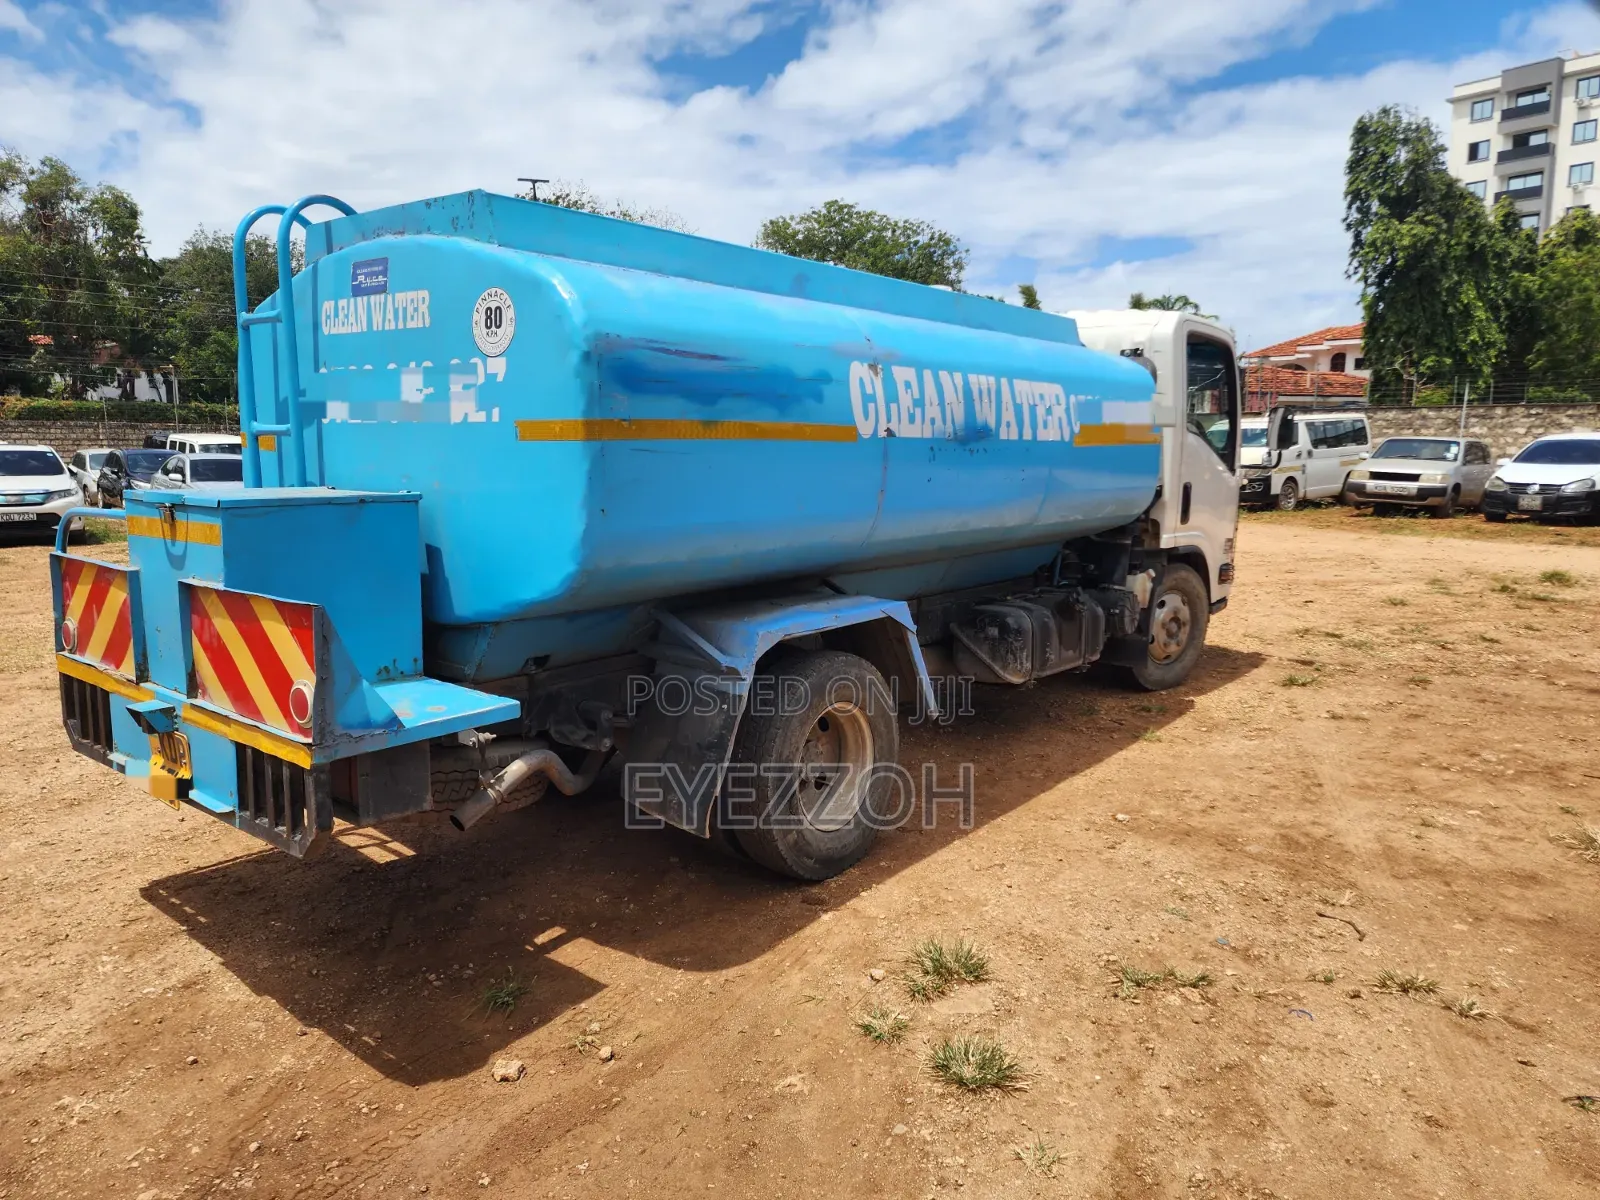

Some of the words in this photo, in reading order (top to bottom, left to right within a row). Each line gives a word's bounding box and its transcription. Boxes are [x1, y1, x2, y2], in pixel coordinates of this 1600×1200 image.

[322, 298, 367, 335] CLEAN
[369, 290, 431, 331] WATER
[475, 289, 512, 315] PINNACLE
[484, 305, 503, 330] 80
[849, 360, 966, 439] CLEAN
[967, 373, 1070, 442] WATER
